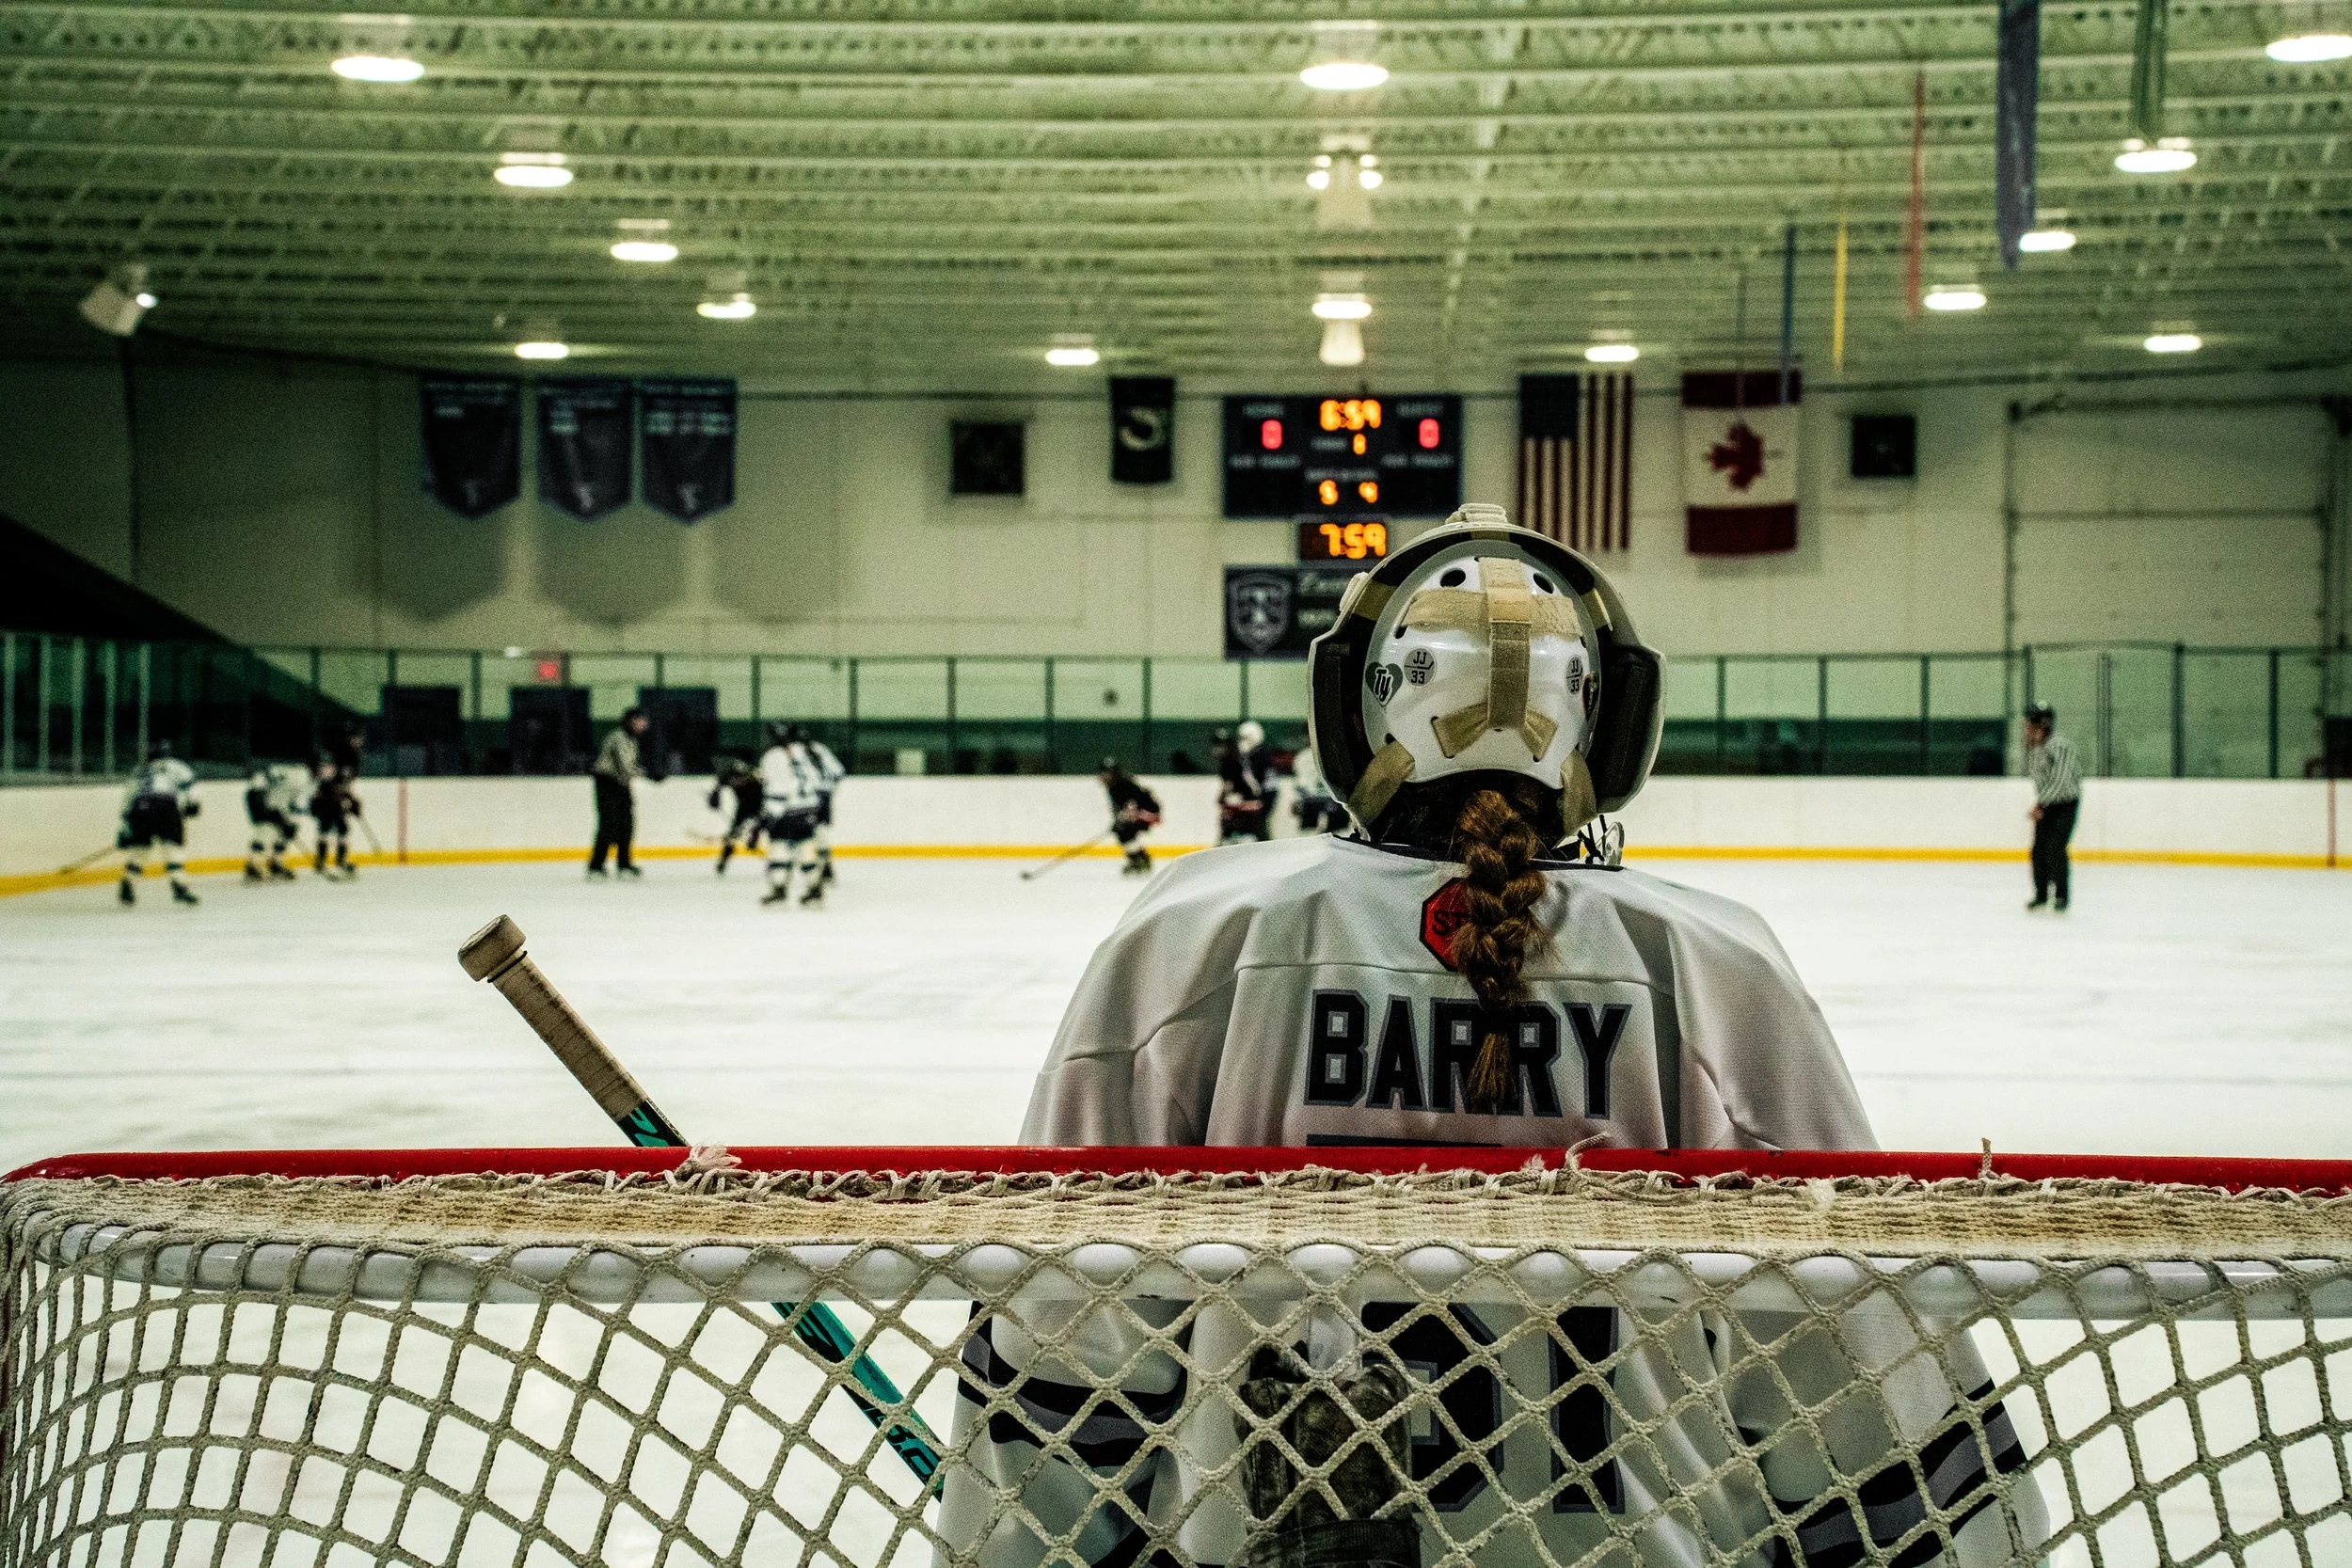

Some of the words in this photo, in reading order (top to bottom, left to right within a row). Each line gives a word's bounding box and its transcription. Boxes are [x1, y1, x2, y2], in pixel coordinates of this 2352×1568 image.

[1320, 523, 1387, 560] 7:59
[1413, 651, 1427, 665] JJ
[1375, 667, 1393, 704] Ty
[1411, 670, 1425, 685] 33
[1570, 678, 1580, 693] 33
[1431, 910, 1470, 937] ST
[1304, 989, 1632, 1120] BARRY
